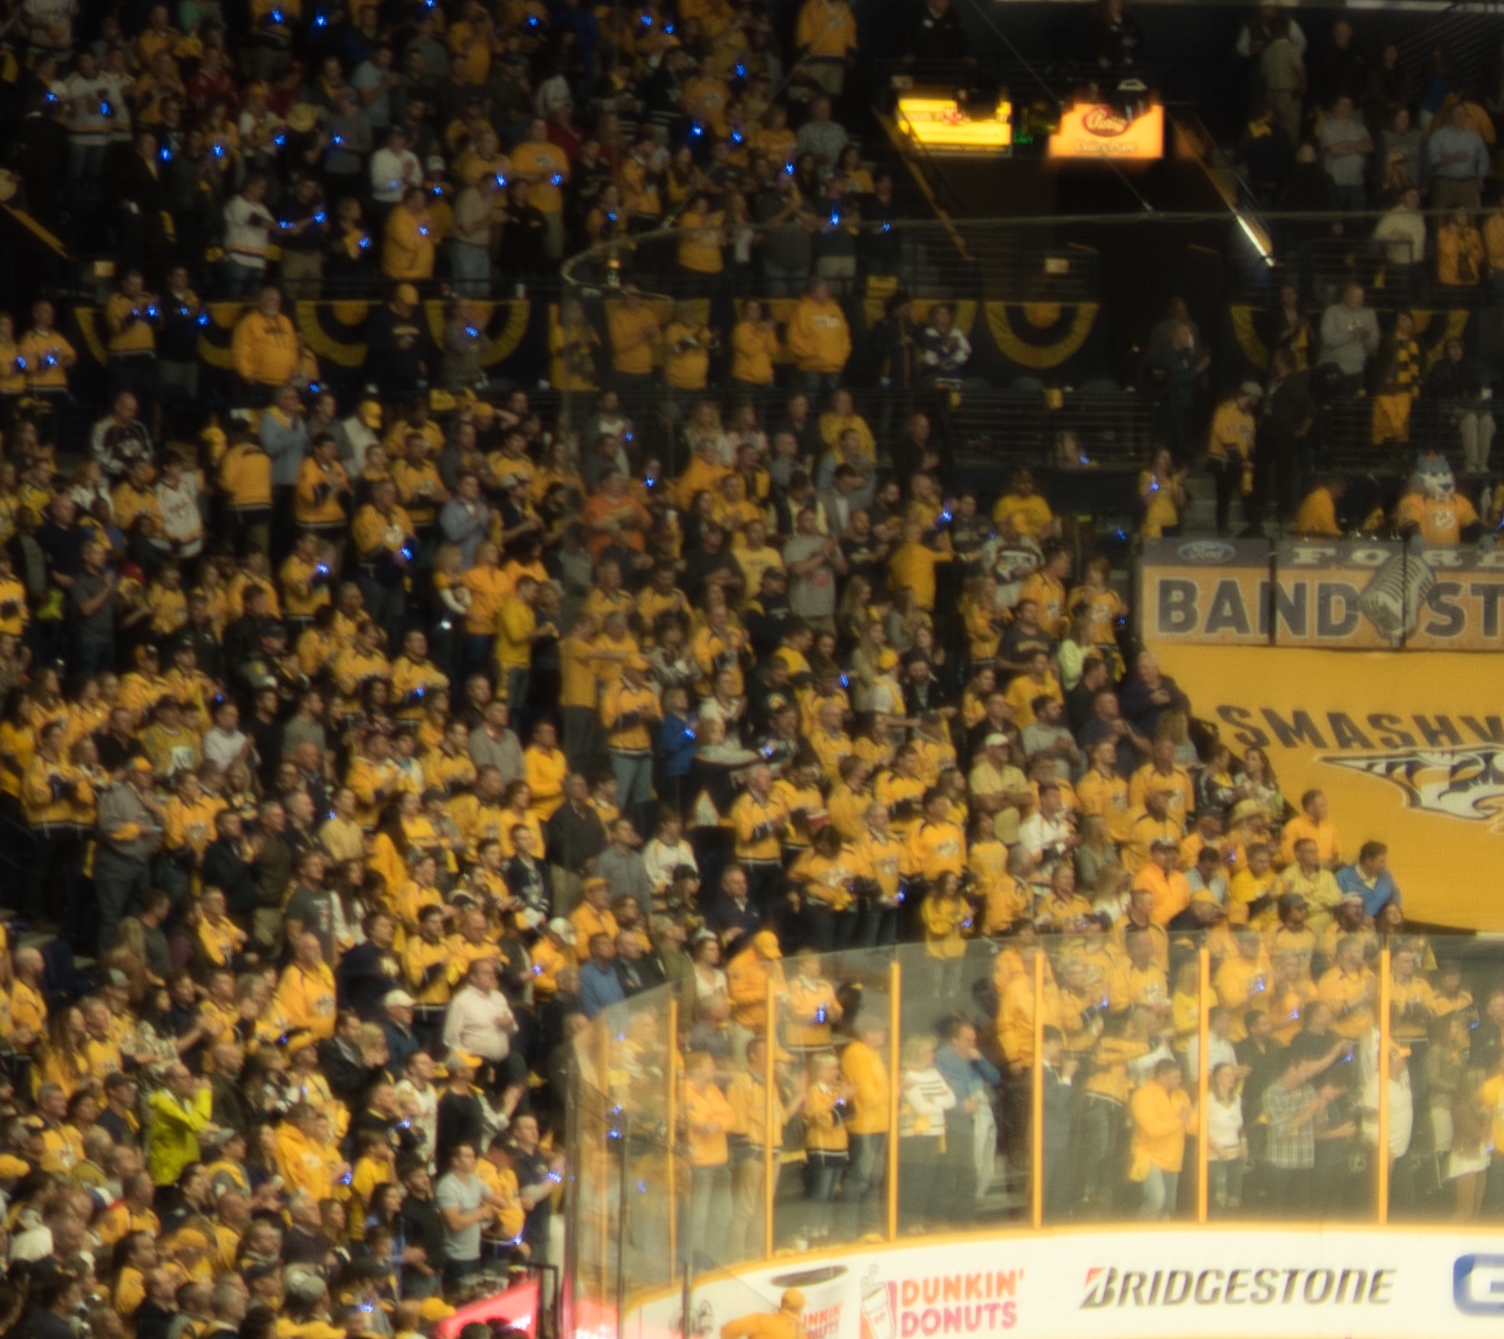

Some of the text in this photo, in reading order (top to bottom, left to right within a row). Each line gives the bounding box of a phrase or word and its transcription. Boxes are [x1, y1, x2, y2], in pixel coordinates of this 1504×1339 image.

[1157, 579, 1362, 638] BAND
[901, 1268, 1025, 1308] DUNKIN'
[1080, 1266, 1397, 1310] BRIDGESTONE
[901, 1301, 1018, 1338] DONUTS
